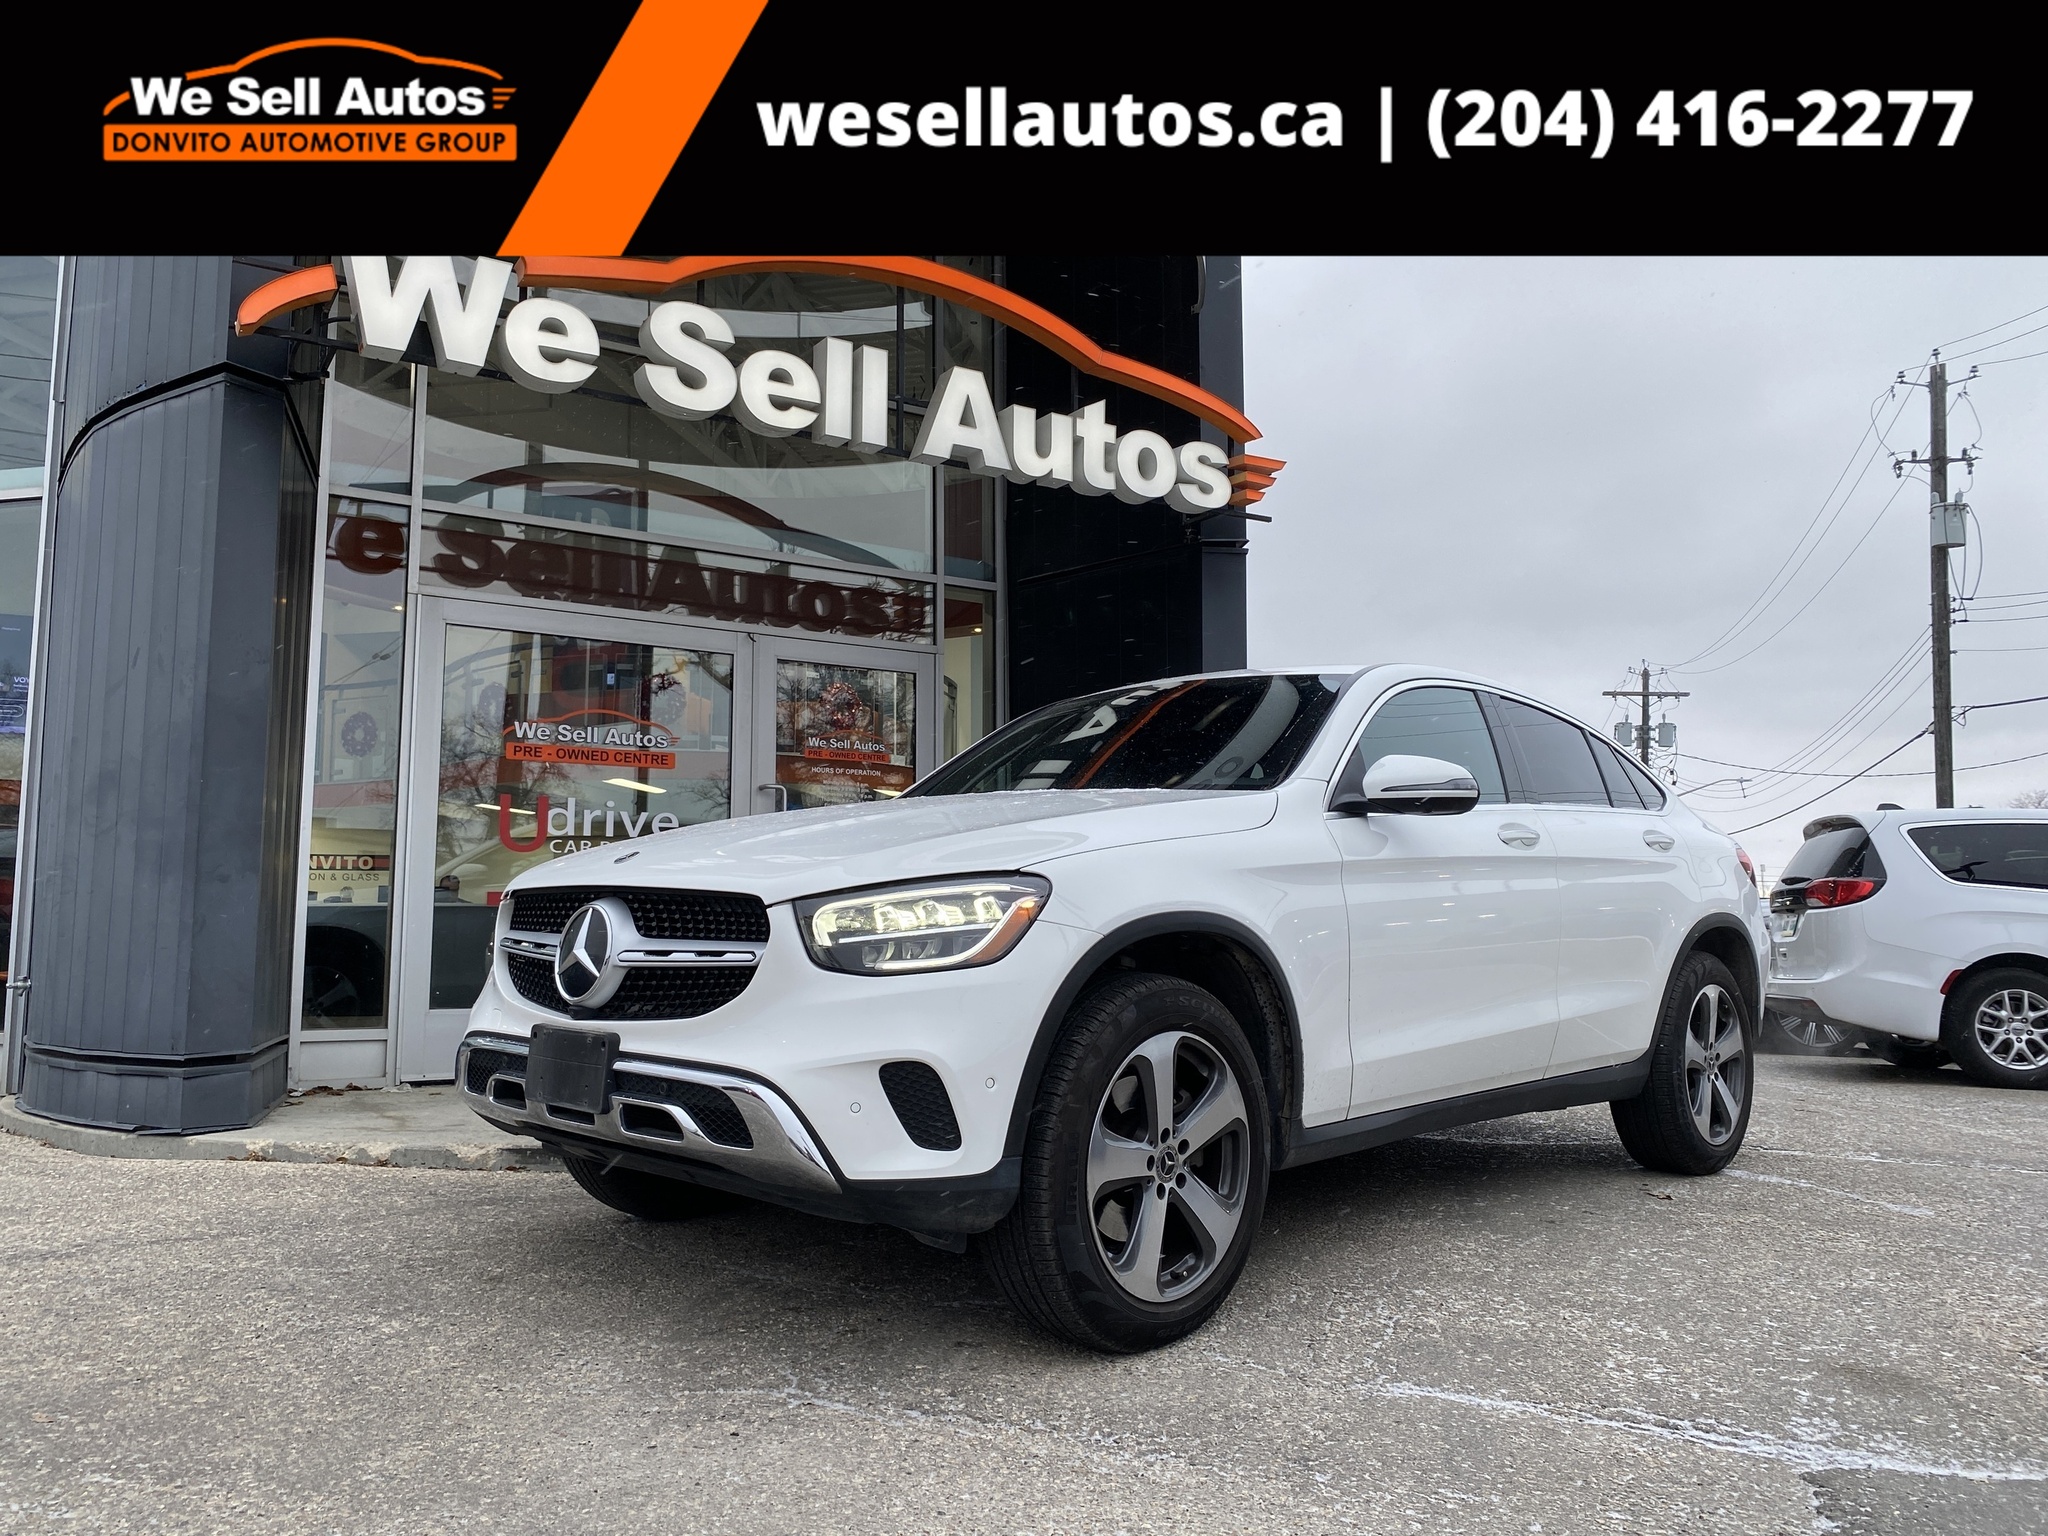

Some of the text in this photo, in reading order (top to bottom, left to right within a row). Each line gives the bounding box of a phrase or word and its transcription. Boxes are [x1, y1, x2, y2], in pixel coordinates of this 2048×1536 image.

[343, 256, 1232, 514] We Sell Autos
[514, 720, 669, 748] We Sell Autos
[808, 737, 886, 751] We Sell Autos
[513, 745, 543, 758] PRE
[556, 748, 609, 762] OWNED
[613, 751, 669, 766] CENTRE
[808, 750, 823, 758] PRE
[829, 751, 856, 760] OWNED
[858, 753, 886, 762] CENTRE
[811, 766, 881, 776] HOURS OF OPERATION
[330, 873, 337, 881] &
[342, 872, 380, 882] GLASS
